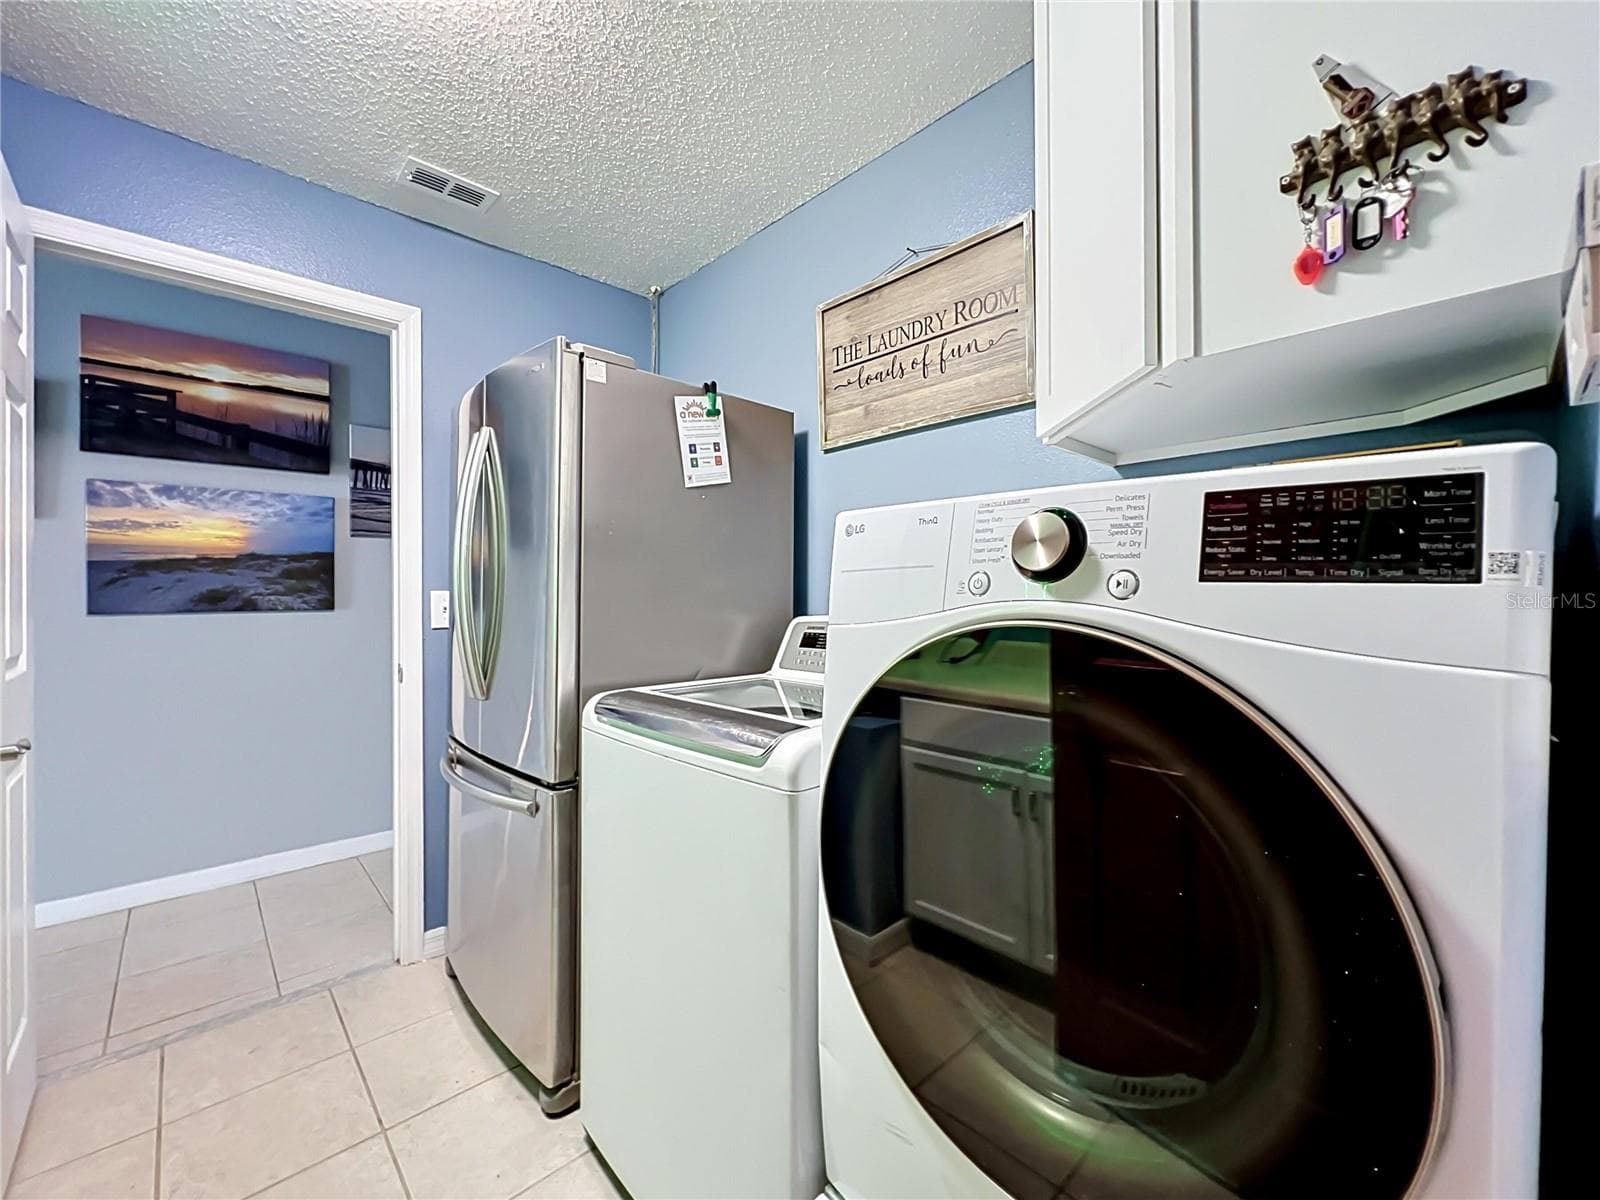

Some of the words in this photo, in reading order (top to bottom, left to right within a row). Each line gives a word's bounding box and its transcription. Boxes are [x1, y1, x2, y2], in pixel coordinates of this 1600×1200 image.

[832, 341, 863, 367] THE
[867, 309, 948, 356] LAUNDRY
[954, 285, 1020, 325] ROOM
[846, 355, 905, 389] loads
[911, 343, 933, 379] of
[940, 335, 996, 374] fun
[687, 410, 704, 419] new
[1114, 493, 1146, 502] Delicates
[918, 516, 938, 526] ThinQ
[1108, 529, 1128, 537] Speed
[1130, 528, 1142, 537] Dry
[1129, 540, 1142, 548] Dry
[1203, 568, 1225, 576] Energy
[1378, 569, 1403, 577] Signal
[1440, 568, 1452, 576] Dry
